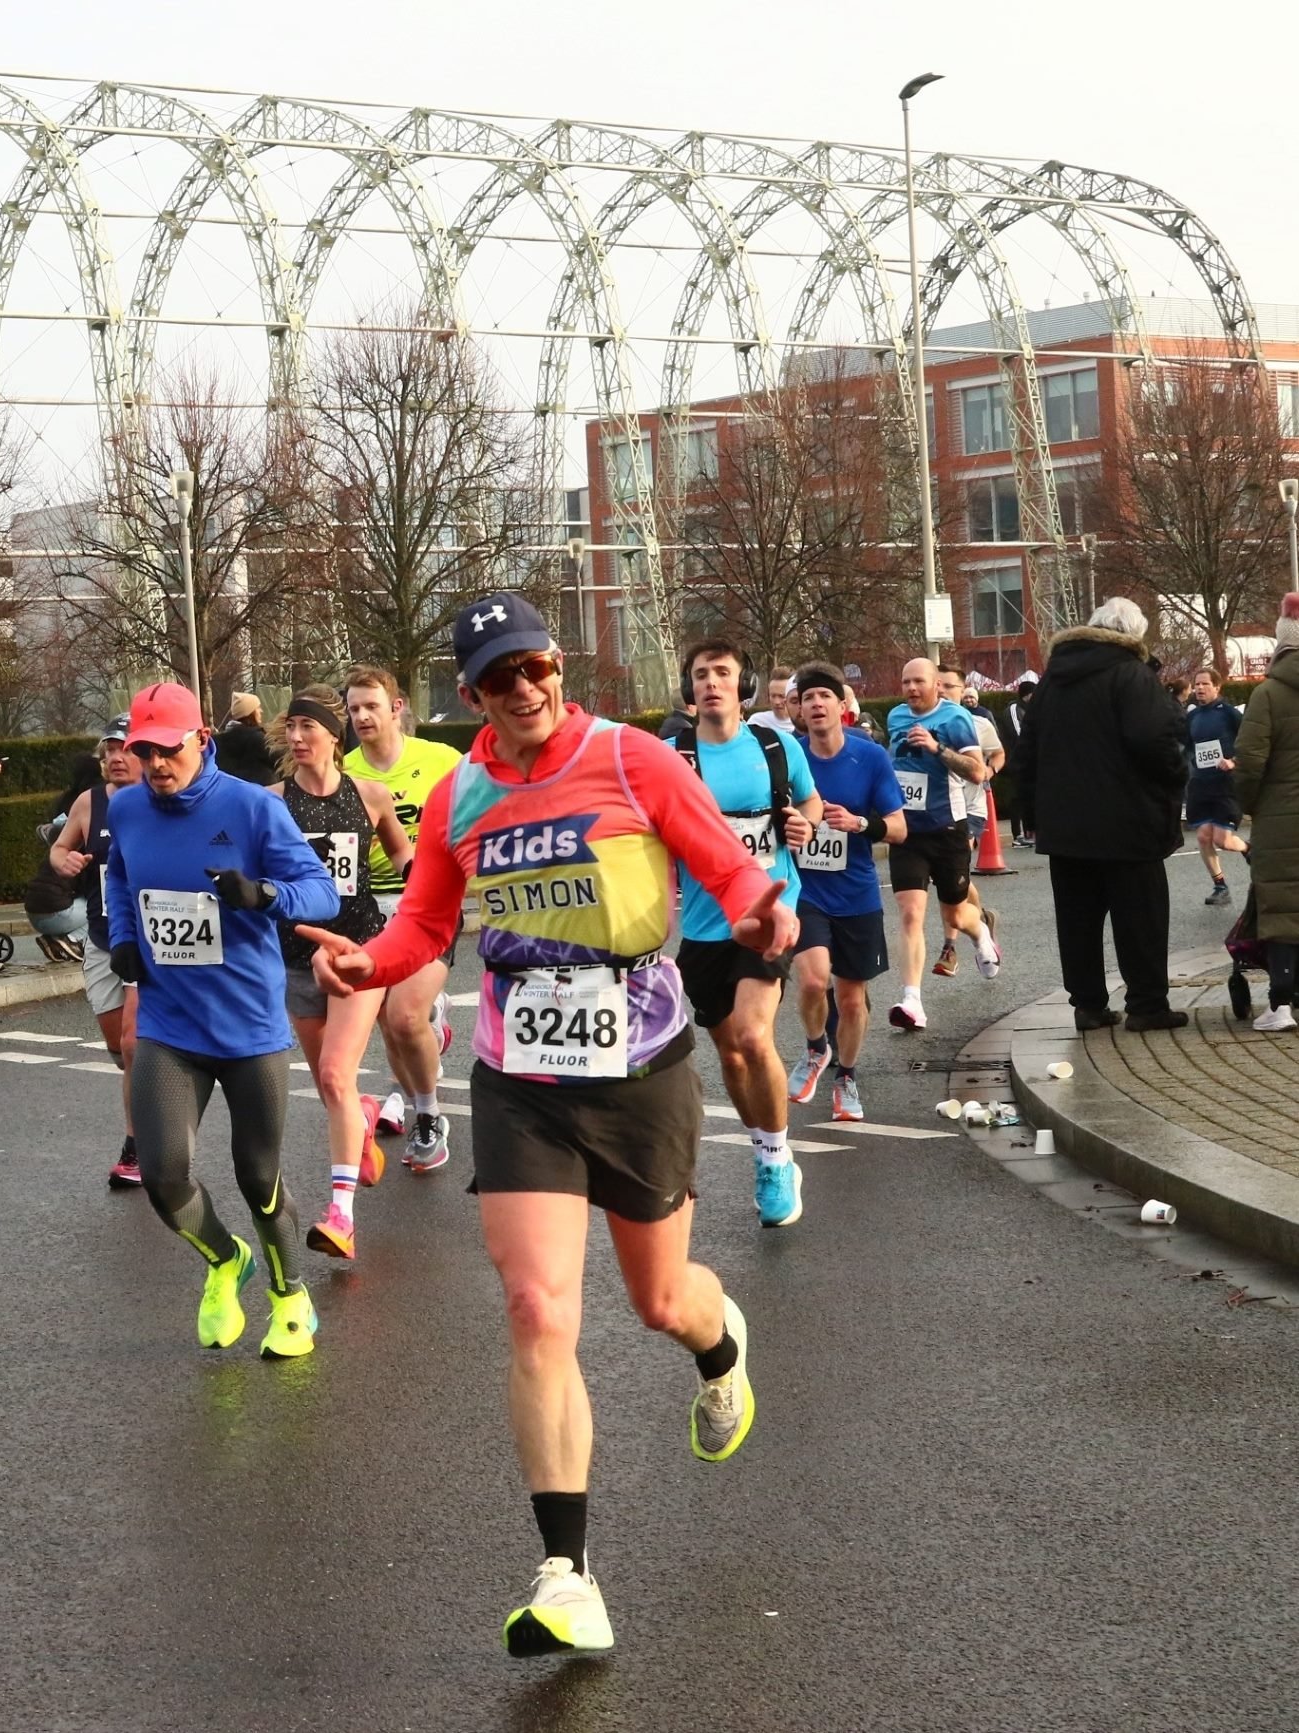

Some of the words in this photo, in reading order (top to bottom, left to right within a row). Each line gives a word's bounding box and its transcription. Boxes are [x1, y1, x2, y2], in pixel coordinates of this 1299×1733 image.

[1197, 749, 1220, 762] 3565
[901, 786, 923, 801] 94
[483, 826, 577, 868] Kids
[484, 878, 597, 915] SIMON
[149, 917, 214, 946] 3324
[162, 951, 195, 959] FLUOR
[523, 990, 550, 999] WINTER
[514, 1006, 618, 1048] 3248
[539, 1054, 588, 1067] FLUOR
